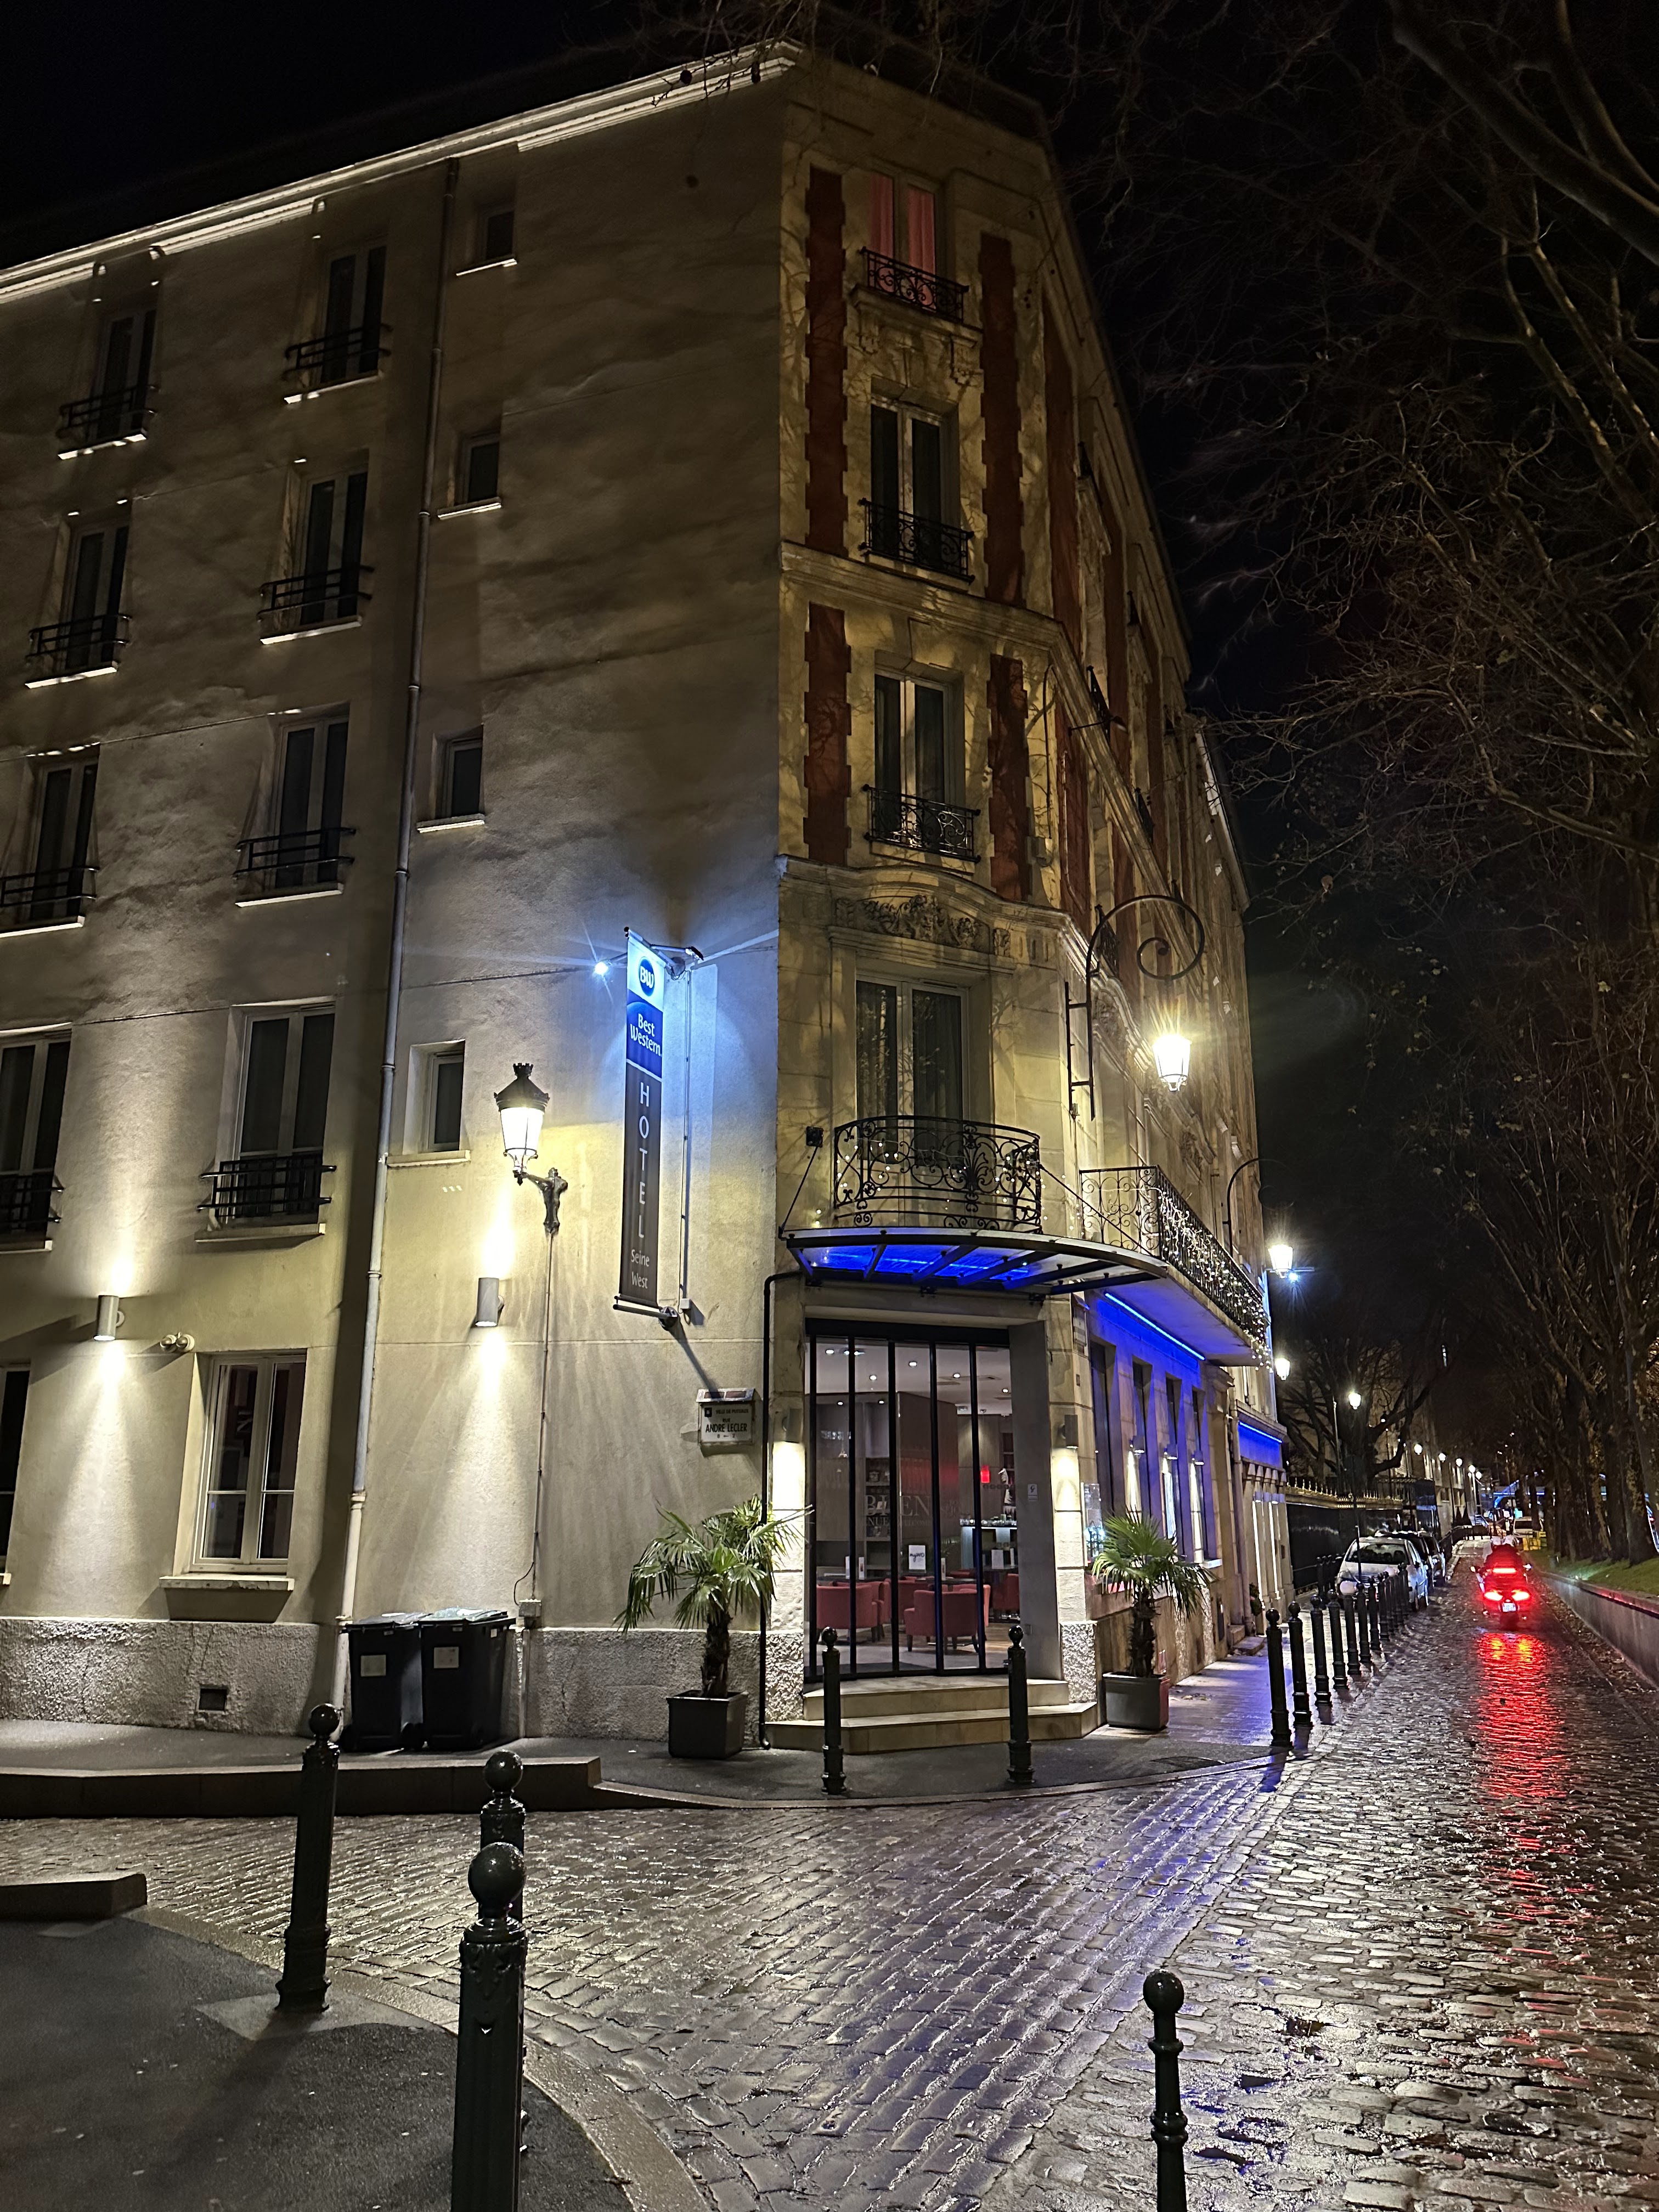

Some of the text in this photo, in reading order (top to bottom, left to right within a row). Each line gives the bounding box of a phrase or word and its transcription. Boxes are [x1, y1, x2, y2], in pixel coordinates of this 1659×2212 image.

[639, 966, 654, 989] BW
[638, 1013, 655, 1037] Best
[639, 1082, 650, 1238] HOTEL
[631, 1249, 650, 1267] Seine
[631, 1271, 648, 1289] West
[706, 1423, 747, 1432] ANDRE LECLER
